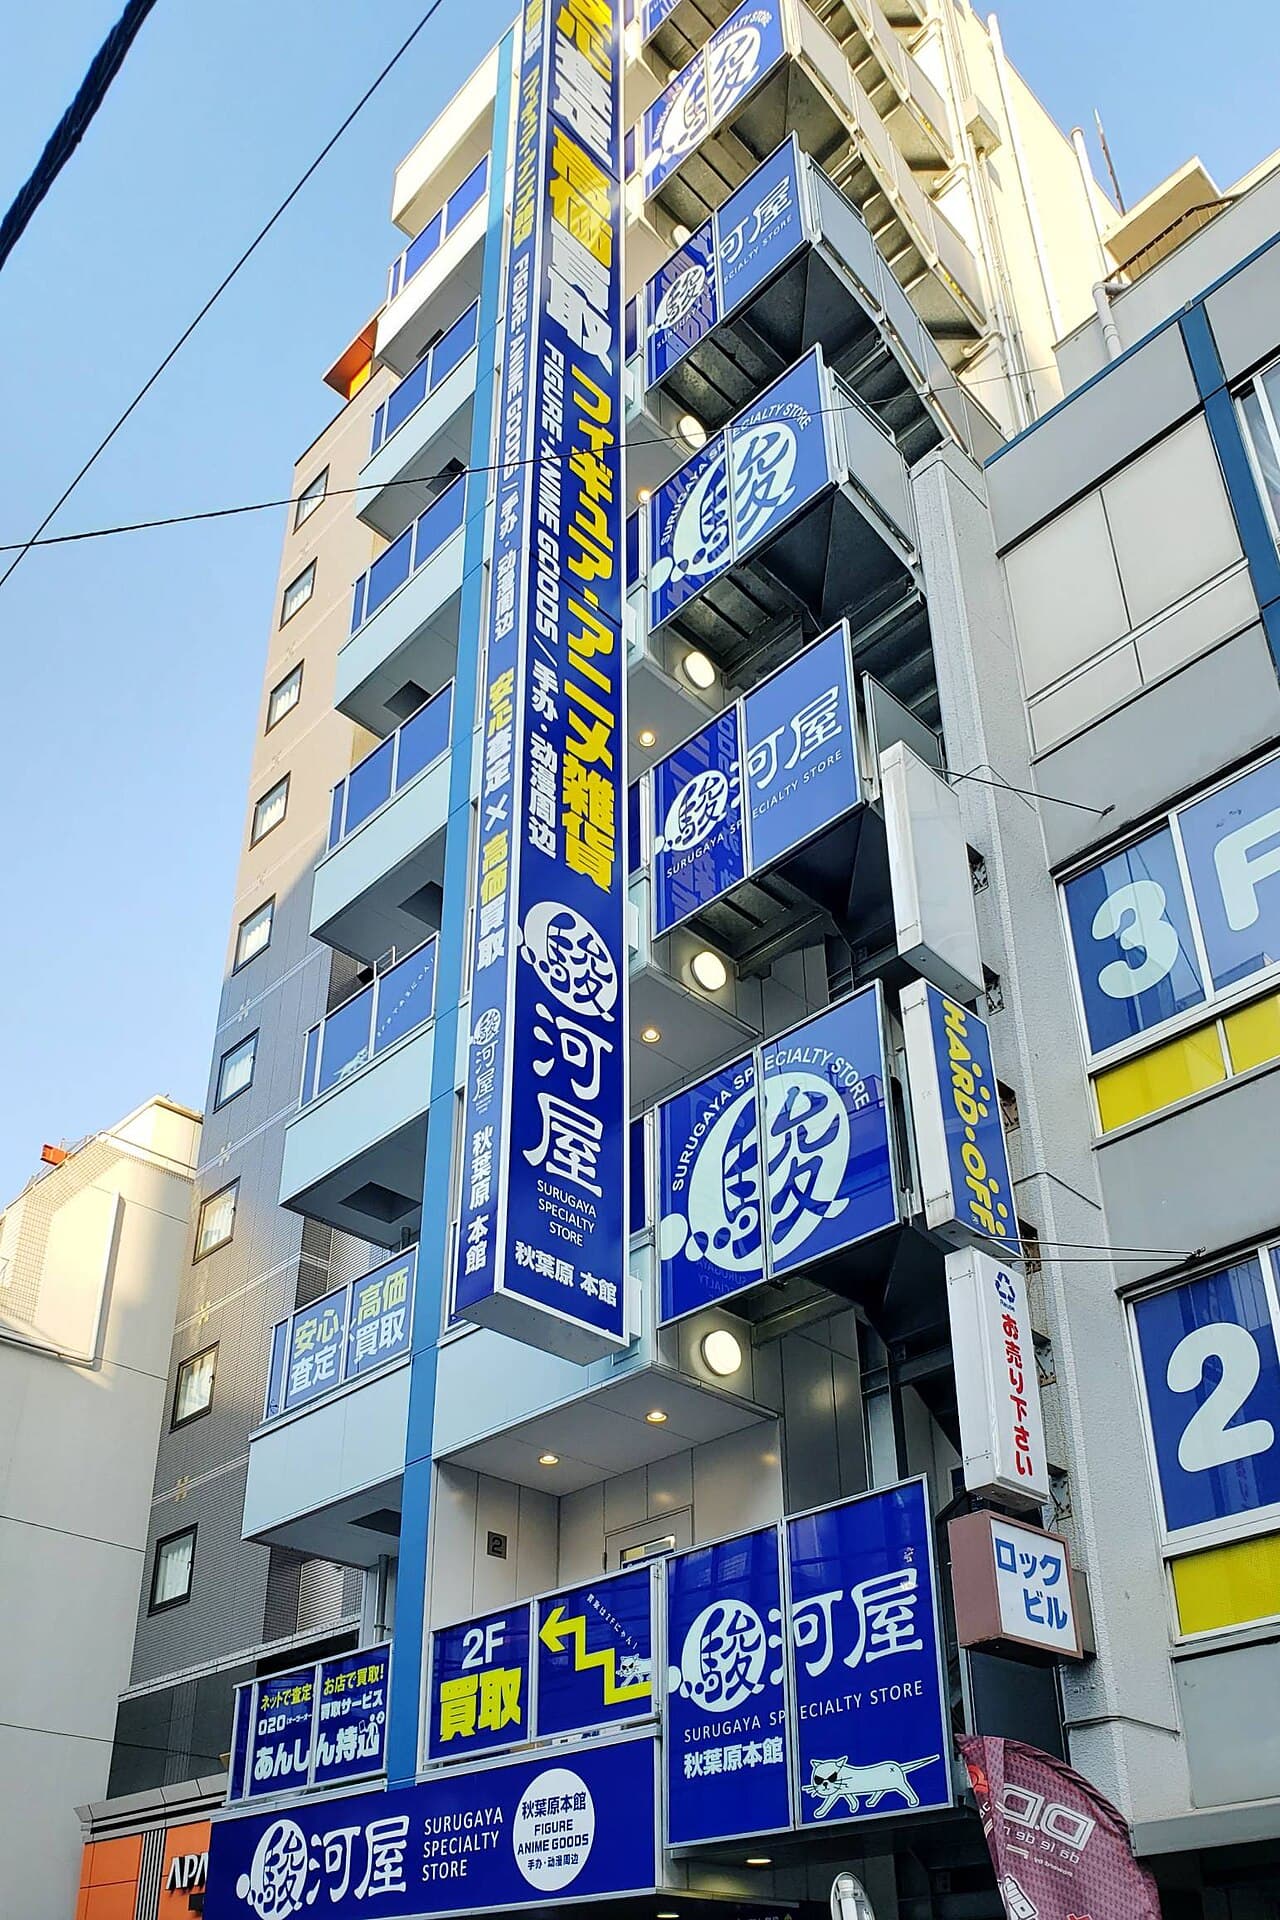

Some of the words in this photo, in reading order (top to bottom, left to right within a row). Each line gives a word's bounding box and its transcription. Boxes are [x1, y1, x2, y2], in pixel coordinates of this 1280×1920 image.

[762, 214, 793, 246] STORE
[782, 402, 813, 432] STORE
[666, 833, 725, 879] SURUGAYA
[803, 750, 843, 784] STORE
[672, 1090, 732, 1192] SURUGAYA
[831, 1057, 870, 1110] STORE
[537, 1180, 597, 1217] SURUGAYA
[538, 1198, 595, 1234] SPECIALTY
[549, 1221, 583, 1247] STORE
[1002, 1313, 1033, 1477] お売り下さい
[1167, 1322, 1275, 1473] 2
[995, 1537, 1062, 1587] ロック
[1023, 1588, 1068, 1630] ビル
[461, 1621, 506, 1670] 2F
[440, 1667, 522, 1742] 買取
[684, 1714, 761, 1743] SURUGAYA
[769, 1693, 862, 1725] SPECIALTY
[870, 1680, 923, 1706] STORE
[684, 1735, 784, 1779] 秋葉原本館
[424, 1807, 503, 1836] SURUGAYA
[521, 1792, 587, 1820] 秋葉原本館
[423, 1831, 500, 1858] SPECIALTY
[517, 1838, 550, 1856] ANIME
[551, 1833, 589, 1851] GOODS
[534, 1819, 573, 1836] FIGURE
[422, 1860, 468, 1881] STORE
